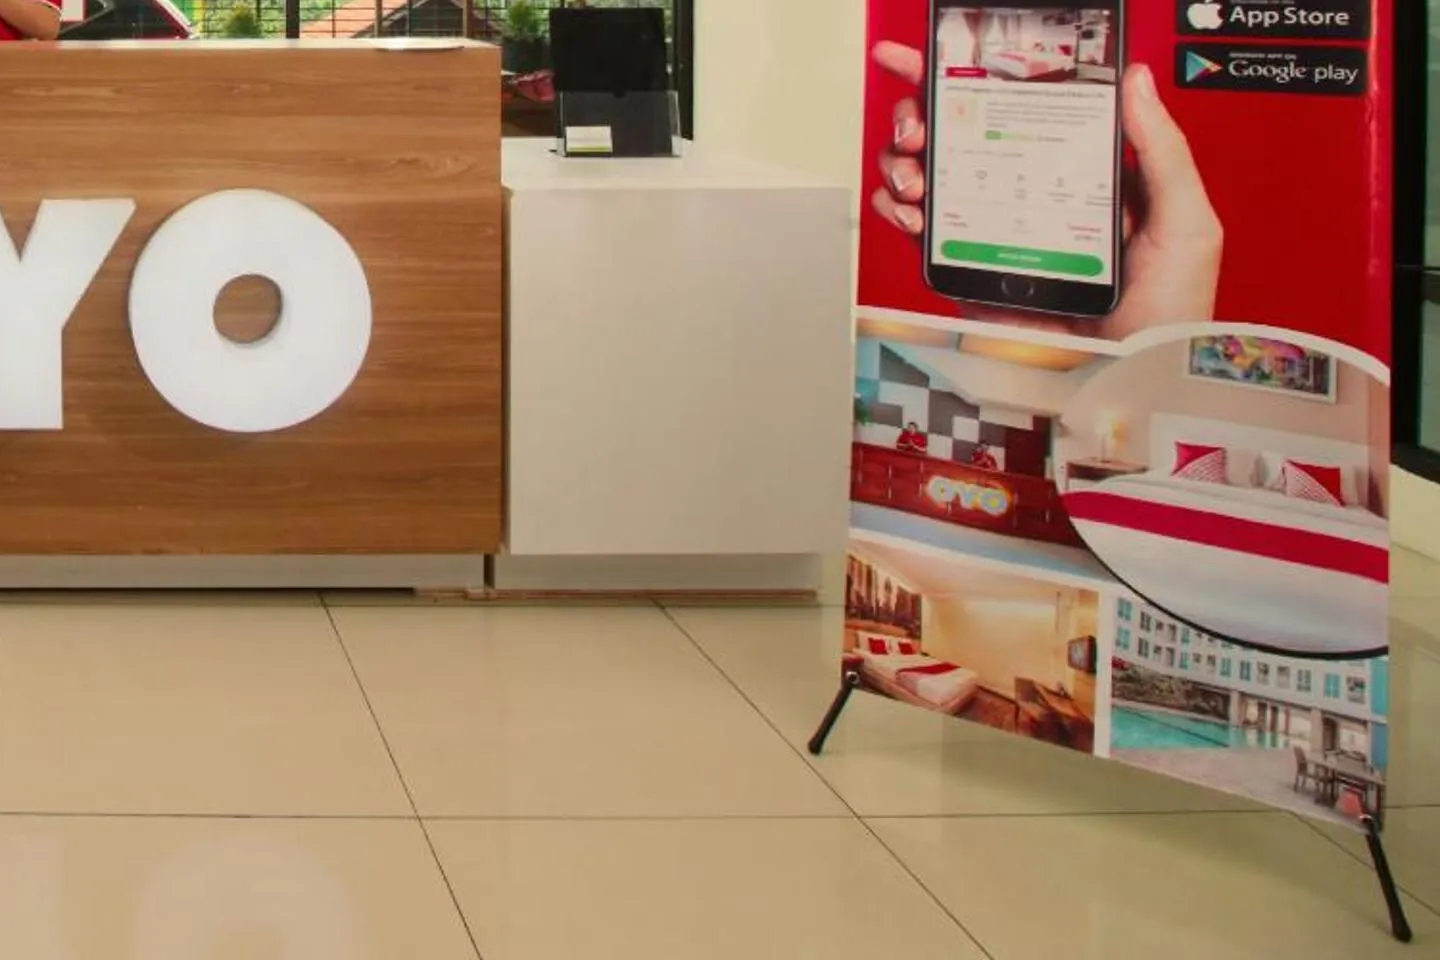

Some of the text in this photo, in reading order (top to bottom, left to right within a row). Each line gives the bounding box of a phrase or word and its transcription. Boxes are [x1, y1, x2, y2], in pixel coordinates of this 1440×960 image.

[1229, 5, 1351, 28] App Store
[1228, 59, 1359, 86] Google play
